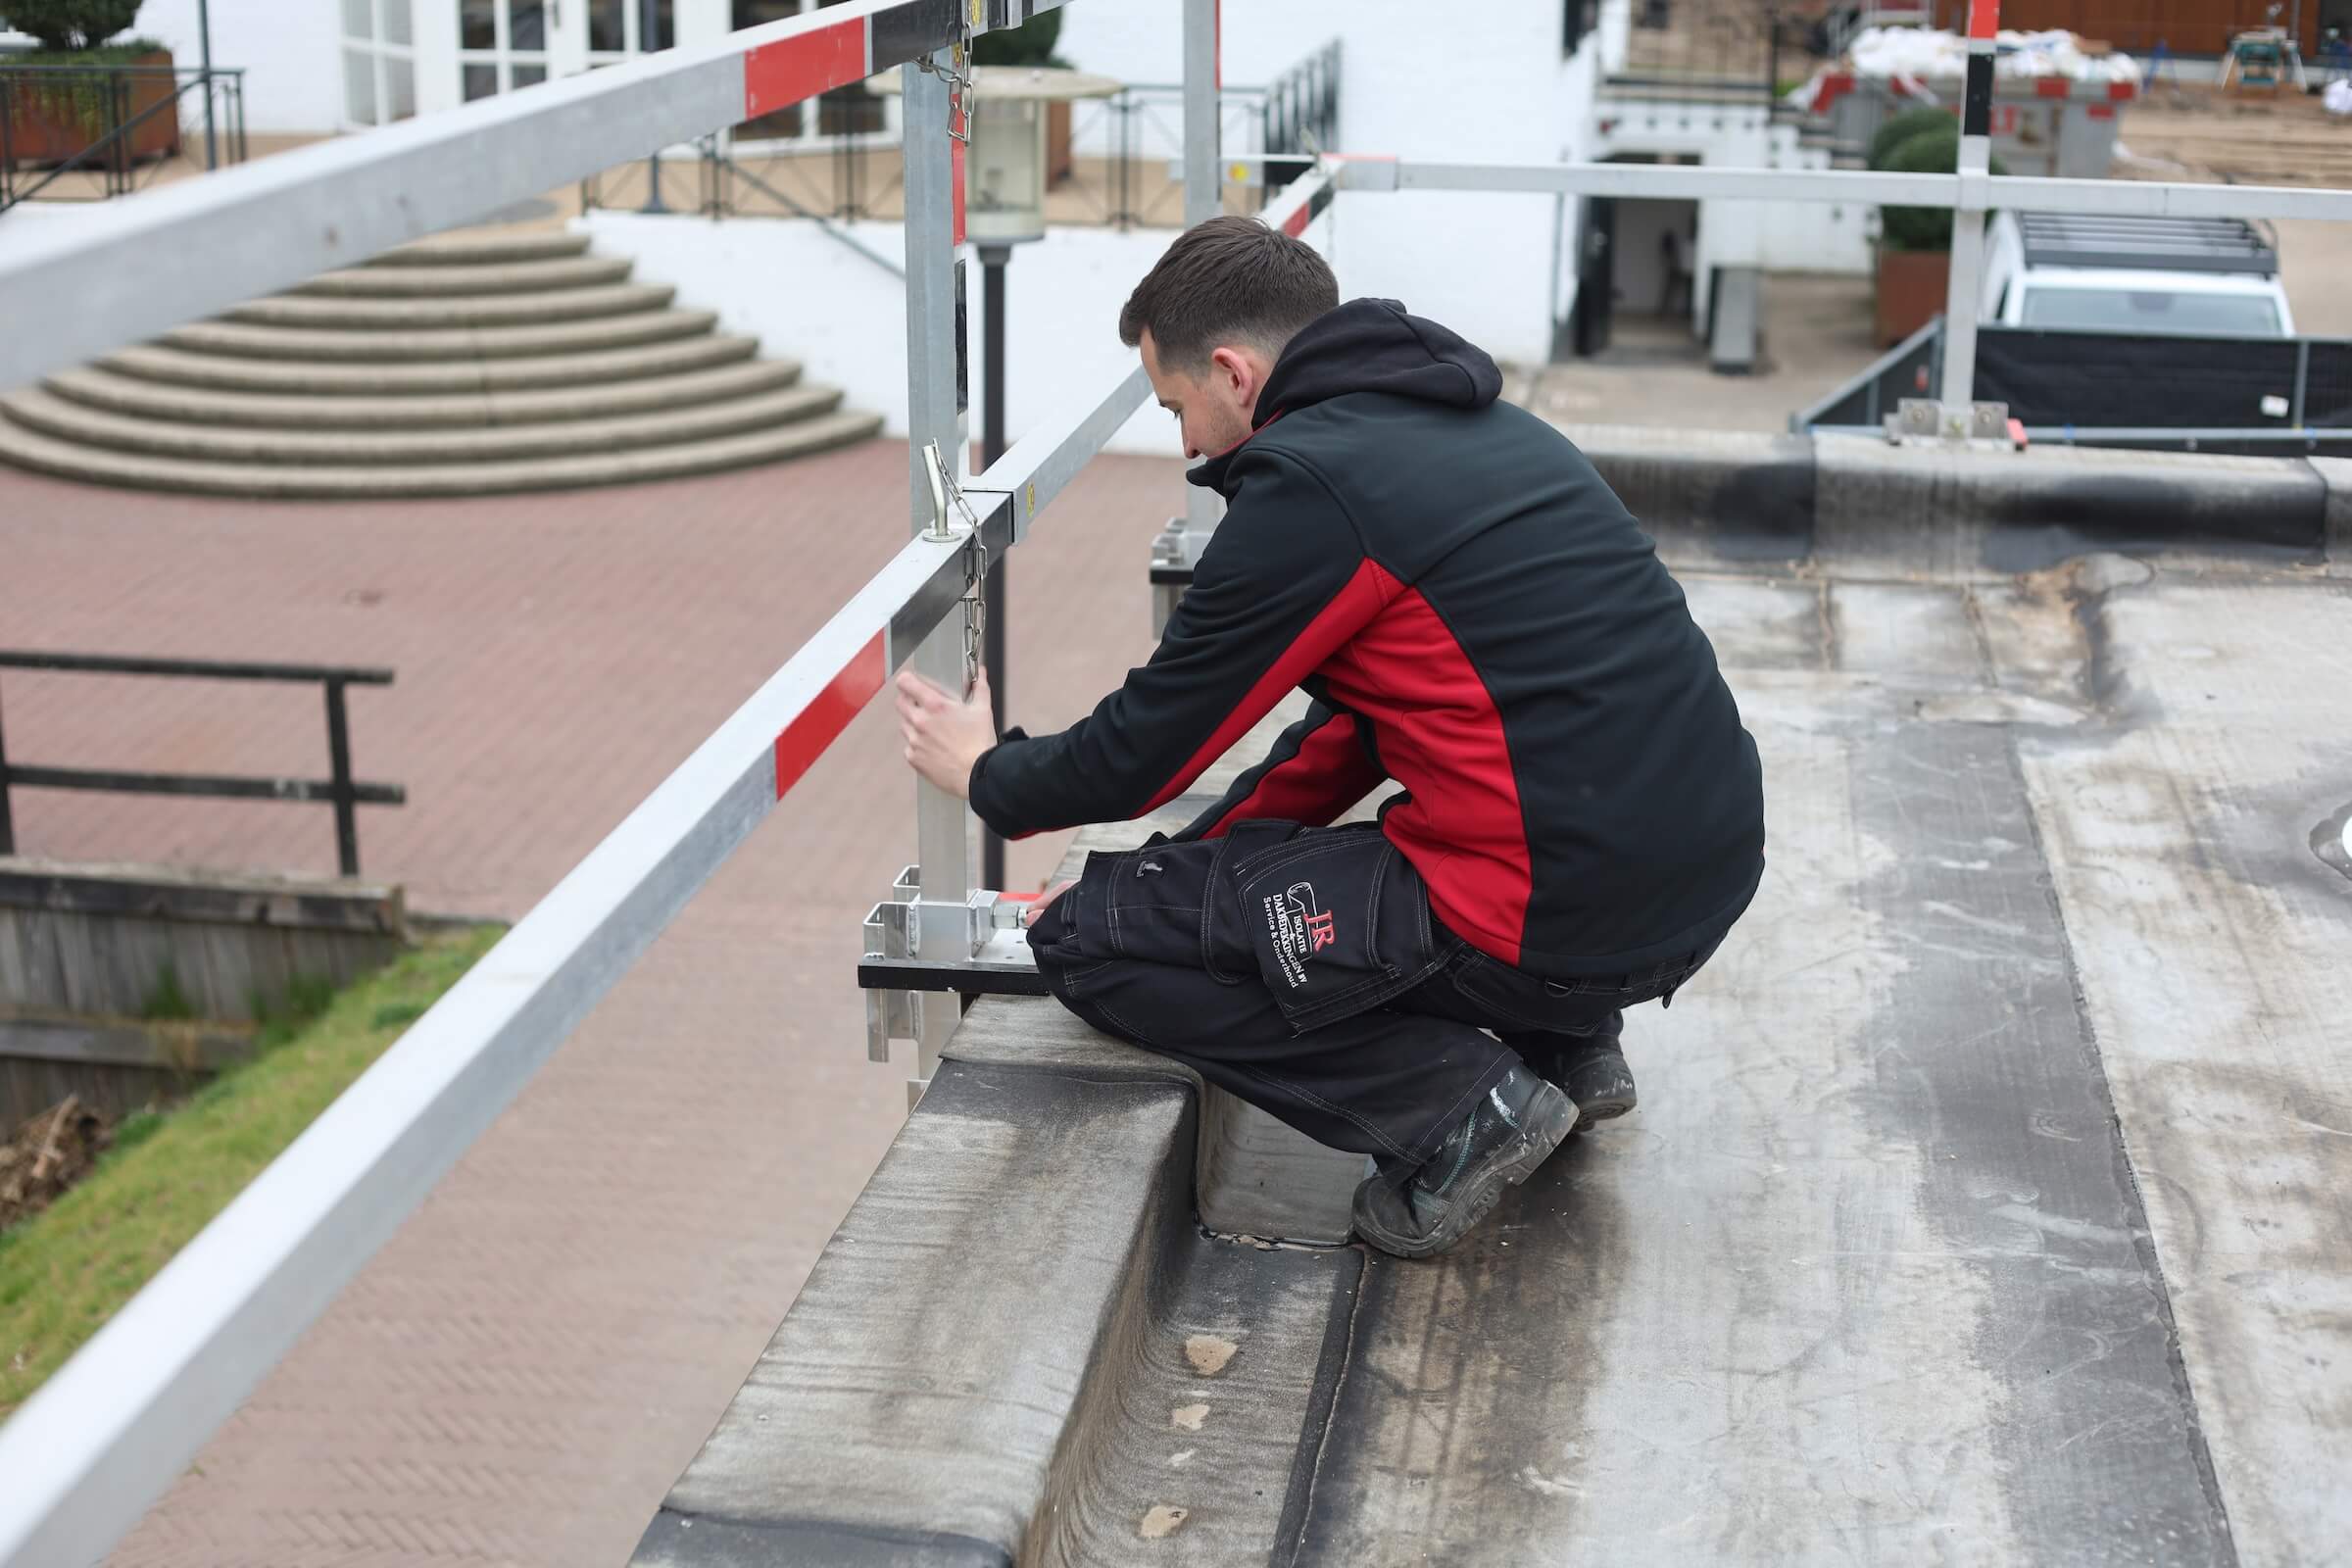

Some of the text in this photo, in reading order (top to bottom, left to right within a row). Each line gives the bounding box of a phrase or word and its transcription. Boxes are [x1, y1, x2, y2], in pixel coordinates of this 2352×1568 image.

[1263, 896, 1276, 931] Service
[1273, 940, 1299, 989] Onderhoud
[1293, 914, 1307, 955] ISOLATIE
[1303, 909, 1336, 953] JR
